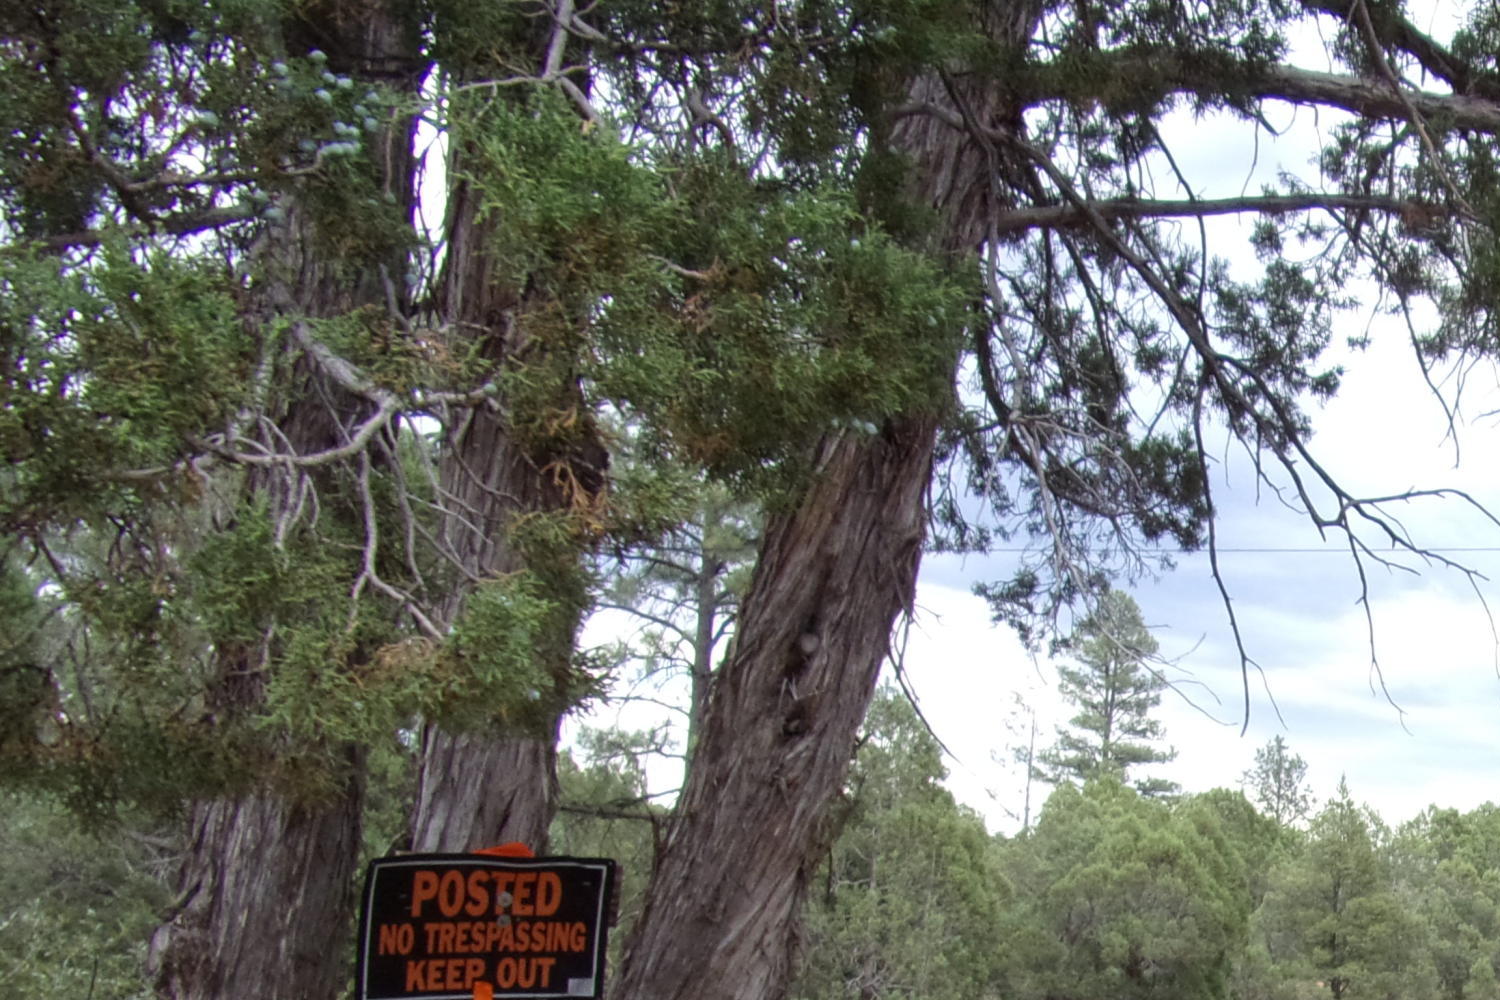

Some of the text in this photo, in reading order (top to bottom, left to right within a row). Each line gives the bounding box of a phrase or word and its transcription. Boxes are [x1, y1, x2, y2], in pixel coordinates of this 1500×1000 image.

[411, 869, 562, 917] POSTED
[378, 921, 586, 955] NO TRESPASSING
[405, 956, 556, 992] KEEP OUT
